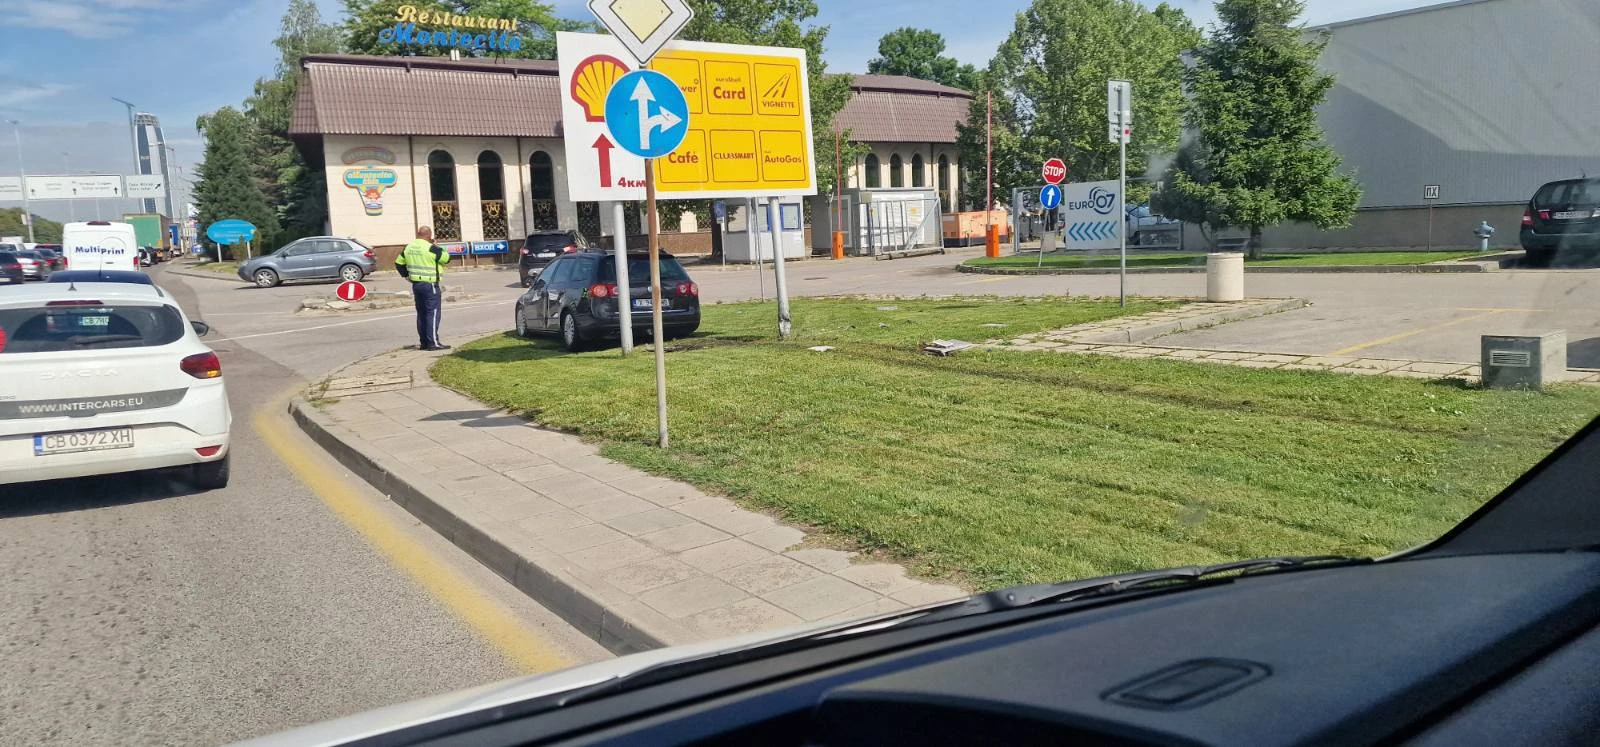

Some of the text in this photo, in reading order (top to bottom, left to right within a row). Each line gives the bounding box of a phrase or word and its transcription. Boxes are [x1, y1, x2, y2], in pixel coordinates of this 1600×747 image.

[395, 5, 518, 31] Restaurant
[377, 22, 523, 51] Montecito
[713, 86, 746, 99] Card
[762, 101, 795, 109] VIGNETTE
[668, 150, 699, 164] Café
[764, 154, 802, 164] AutoGas
[1044, 165, 1064, 177] STOP
[1426, 187, 1437, 197] ПХ
[40, 368, 120, 380] DACIA
[18, 397, 144, 414] WWW.INTERCARS.EU
[69, 432, 107, 446] 0372
